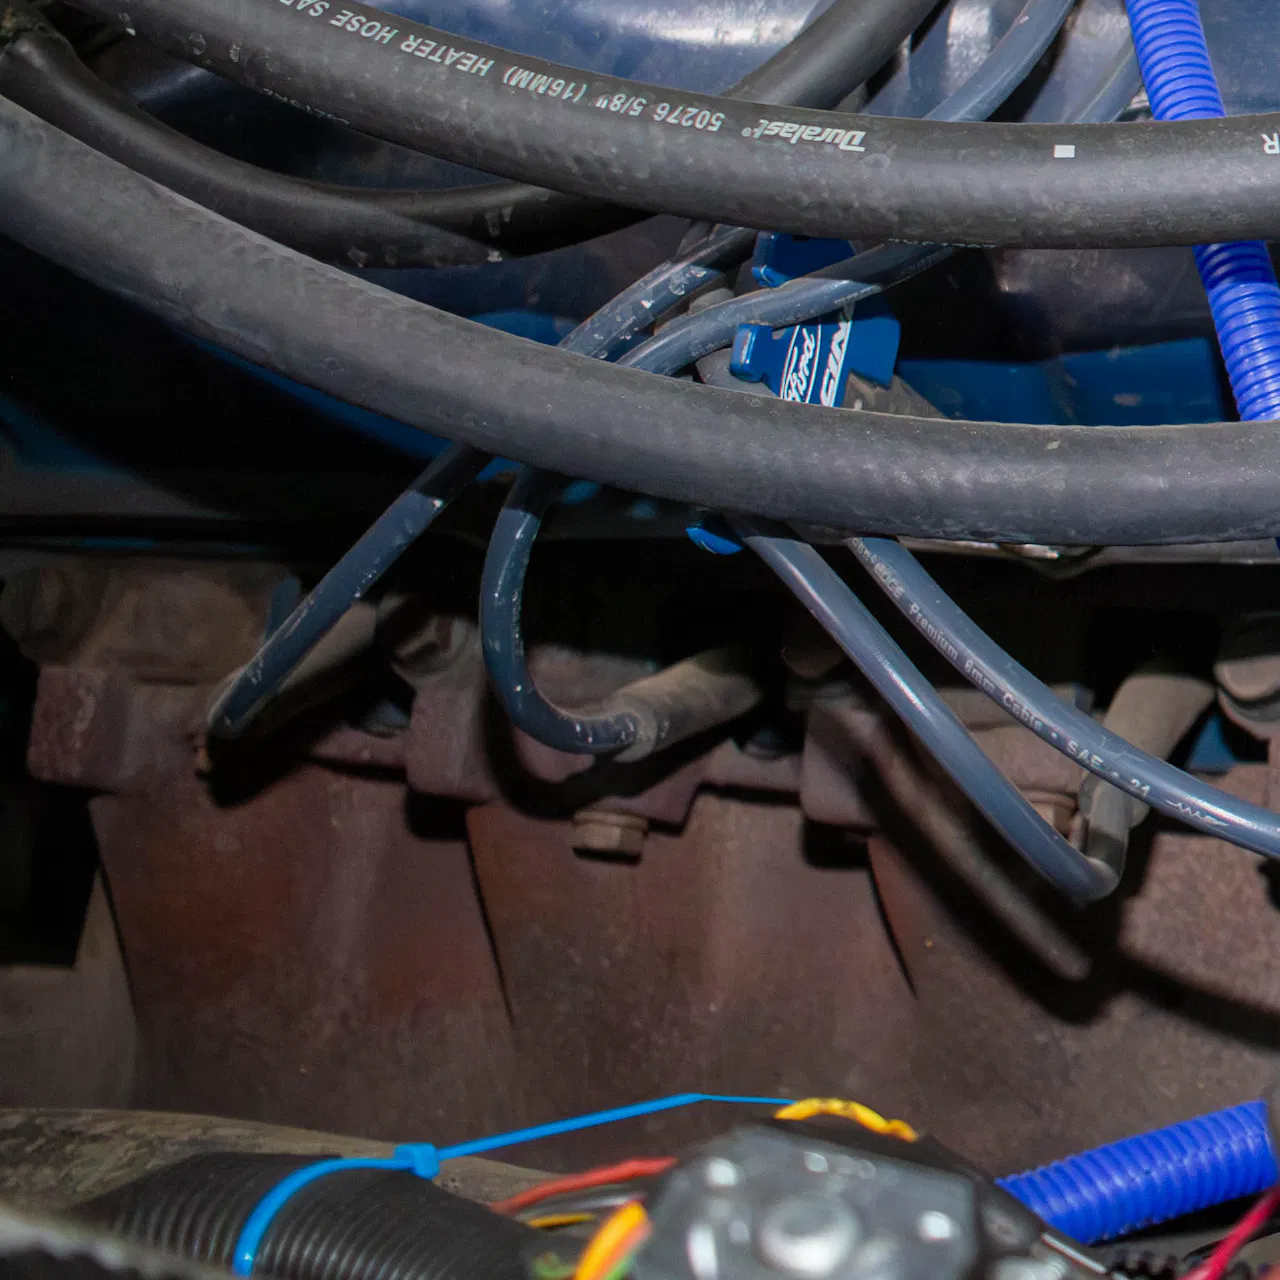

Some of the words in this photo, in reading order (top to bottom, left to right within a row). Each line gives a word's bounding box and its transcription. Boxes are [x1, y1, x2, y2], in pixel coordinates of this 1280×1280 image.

[329, 9, 400, 45] HOSE
[399, 33, 496, 78] HEATER
[502, 65, 588, 104] (16MM)
[595, 92, 647, 118] 5/8"
[652, 101, 726, 133] 50276
[908, 601, 960, 661] Premium
[1002, 692, 1043, 730] Cable
